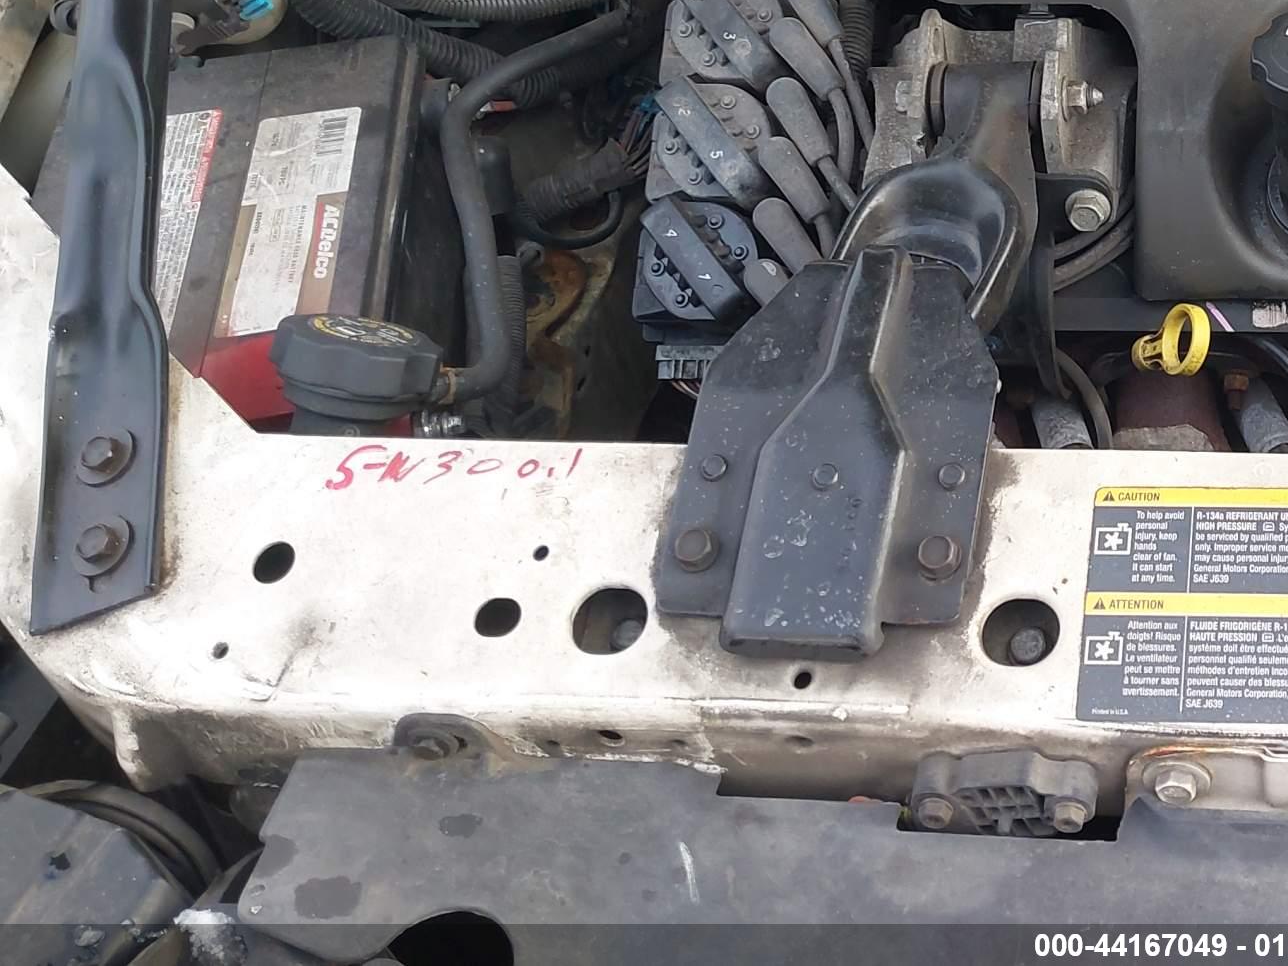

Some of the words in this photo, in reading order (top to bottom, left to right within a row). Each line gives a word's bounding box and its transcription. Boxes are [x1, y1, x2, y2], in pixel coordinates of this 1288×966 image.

[722, 31, 737, 40] 3
[677, 107, 691, 116] 2
[709, 149, 723, 159] 5
[666, 228, 678, 238] 4
[314, 203, 340, 279] ACDelco
[698, 273, 712, 282] 1
[1118, 492, 1160, 501] CAUTION
[1137, 510, 1145, 519] To
[1147, 511, 1163, 520] help
[1165, 511, 1184, 520] avoid
[1226, 511, 1278, 521] REFRIGERANT
[1135, 522, 1168, 530] personal
[1196, 522, 1215, 530] HIGH
[1217, 521, 1257, 531] PRESSURE
[1159, 532, 1177, 541] keep
[1207, 532, 1238, 541] serviced
[1240, 533, 1249, 543] by
[1251, 533, 1283, 542] qualified
[1134, 542, 1157, 550] hands
[1214, 544, 1247, 553] Improper
[1249, 544, 1277, 552] service
[1133, 553, 1152, 561] clear
[1153, 552, 1162, 561] of
[1194, 554, 1210, 562] may
[1212, 554, 1235, 562] cause
[1236, 554, 1269, 563] personal
[1132, 563, 1138, 571] It
[1155, 563, 1173, 571] start
[1194, 564, 1221, 572] General
[1223, 564, 1247, 573] Motors
[1131, 574, 1139, 582] at
[1141, 575, 1155, 583] any
[1156, 574, 1175, 582] time.
[1193, 574, 1208, 583] SAE
[1109, 599, 1164, 610] ATTENTION
[1128, 621, 1162, 630] Attention
[1190, 621, 1218, 630] FLUIDE
[1155, 632, 1181, 641] Risque
[1189, 632, 1216, 641] HAUTE
[1217, 632, 1257, 642] PRESSION
[1126, 643, 1136, 651] de
[1138, 643, 1175, 652] blessures.
[1125, 654, 1135, 662] Le
[1137, 653, 1177, 663] ventilateur
[1124, 665, 1142, 674] peut
[1155, 665, 1180, 674] mettre
[1187, 677, 1218, 686] peuvent
[1220, 678, 1246, 686] causer
[1248, 678, 1262, 687] des
[1122, 687, 1182, 697] avertissement.
[1186, 688, 1215, 697] General
[1216, 688, 1242, 697] Motors
[1244, 689, 1288, 699] Corporation,
[1185, 699, 1201, 708] SAE
